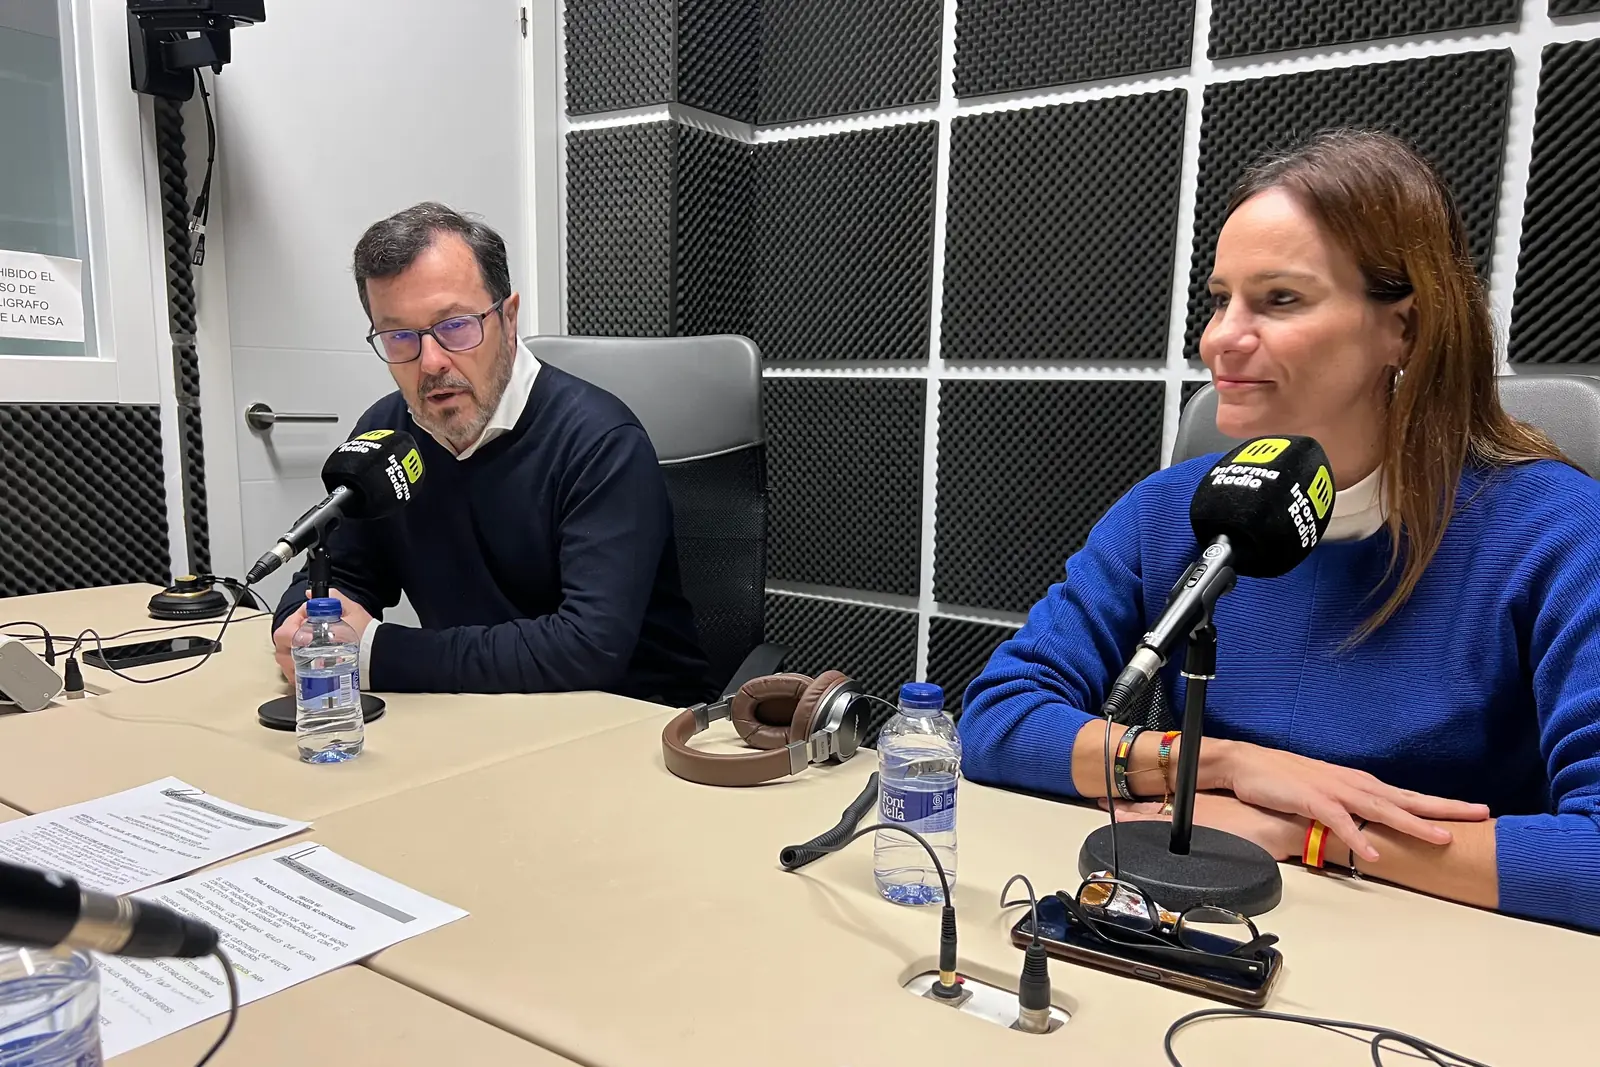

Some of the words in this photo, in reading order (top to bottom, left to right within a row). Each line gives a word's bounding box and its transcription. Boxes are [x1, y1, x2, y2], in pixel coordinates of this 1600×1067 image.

[41, 272, 55, 282] EL
[20, 285, 36, 294] DE
[12, 314, 26, 324] LA
[29, 315, 64, 326] MESA
[387, 454, 411, 501] Informa
[1210, 464, 1280, 480] Informa
[1211, 474, 1262, 488] Radio
[385, 466, 403, 500] Radio
[1290, 482, 1317, 547] Informa
[1287, 502, 1309, 548] Radio
[882, 791, 905, 809] Font
[882, 803, 905, 821] Vella
[200, 882, 223, 895] CONFLICTO
[253, 877, 267, 885] PARLA
[266, 885, 286, 896] NECESITA
[308, 873, 329, 884] REALES
[335, 887, 354, 896] PARLA
[176, 890, 203, 906] DIARIAMENTE
[209, 910, 228, 920] VECINOS
[222, 881, 244, 893] GOBIERNO
[267, 905, 288, 917] FORMADO
[185, 888, 205, 899] MIENTRAS
[237, 918, 264, 933] PROBLEMAS
[265, 933, 283, 943] REALES
[296, 950, 315, 961] SUFREN
[256, 907, 277, 918] DEBATES
[277, 918, 317, 939] INTERNACIONALES
[130, 963, 152, 978] MUNICIPIO
[270, 959, 290, 971] AFECTAN
[162, 966, 193, 986] ESTABLEZCAN
[198, 989, 214, 998] PARLA
